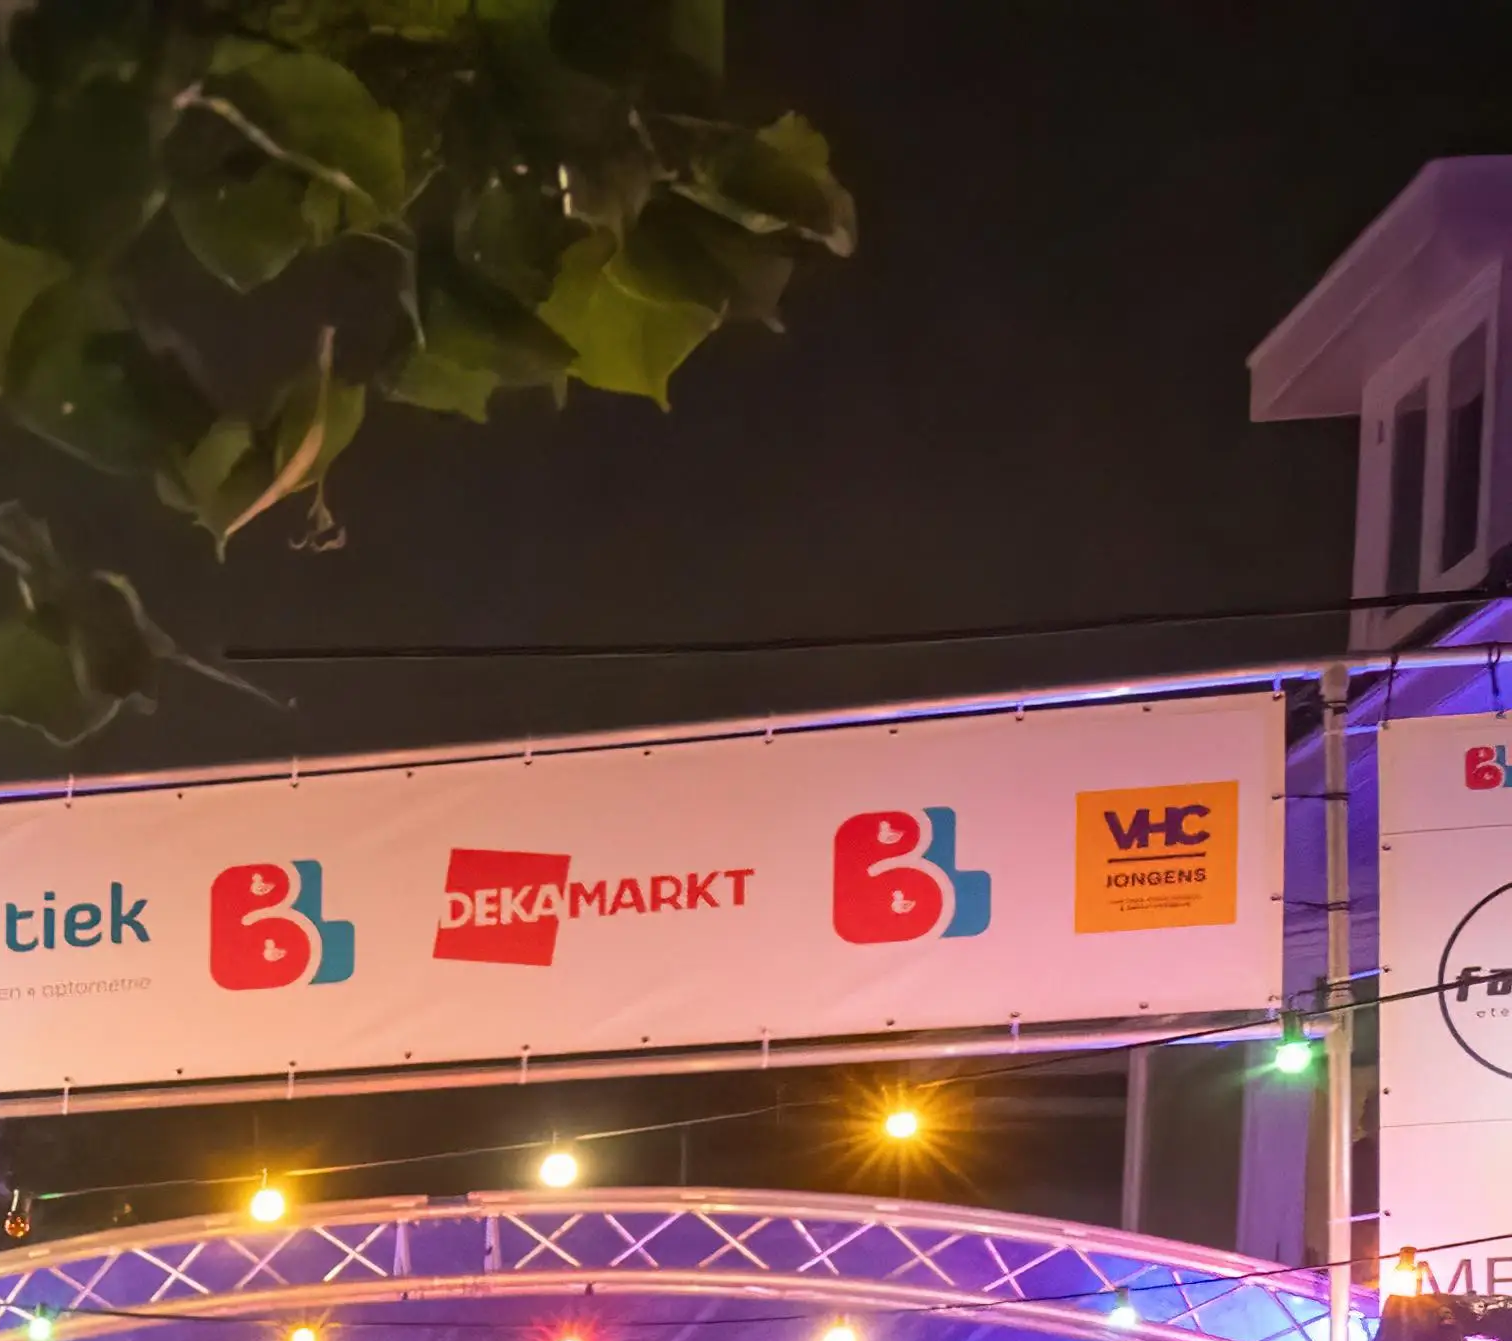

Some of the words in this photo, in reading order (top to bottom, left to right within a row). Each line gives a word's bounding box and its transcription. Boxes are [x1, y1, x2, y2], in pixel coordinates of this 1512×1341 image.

[1104, 804, 1211, 850] VHC
[439, 867, 755, 929] DEKAMARKT
[1106, 868, 1206, 889] JONGENS
